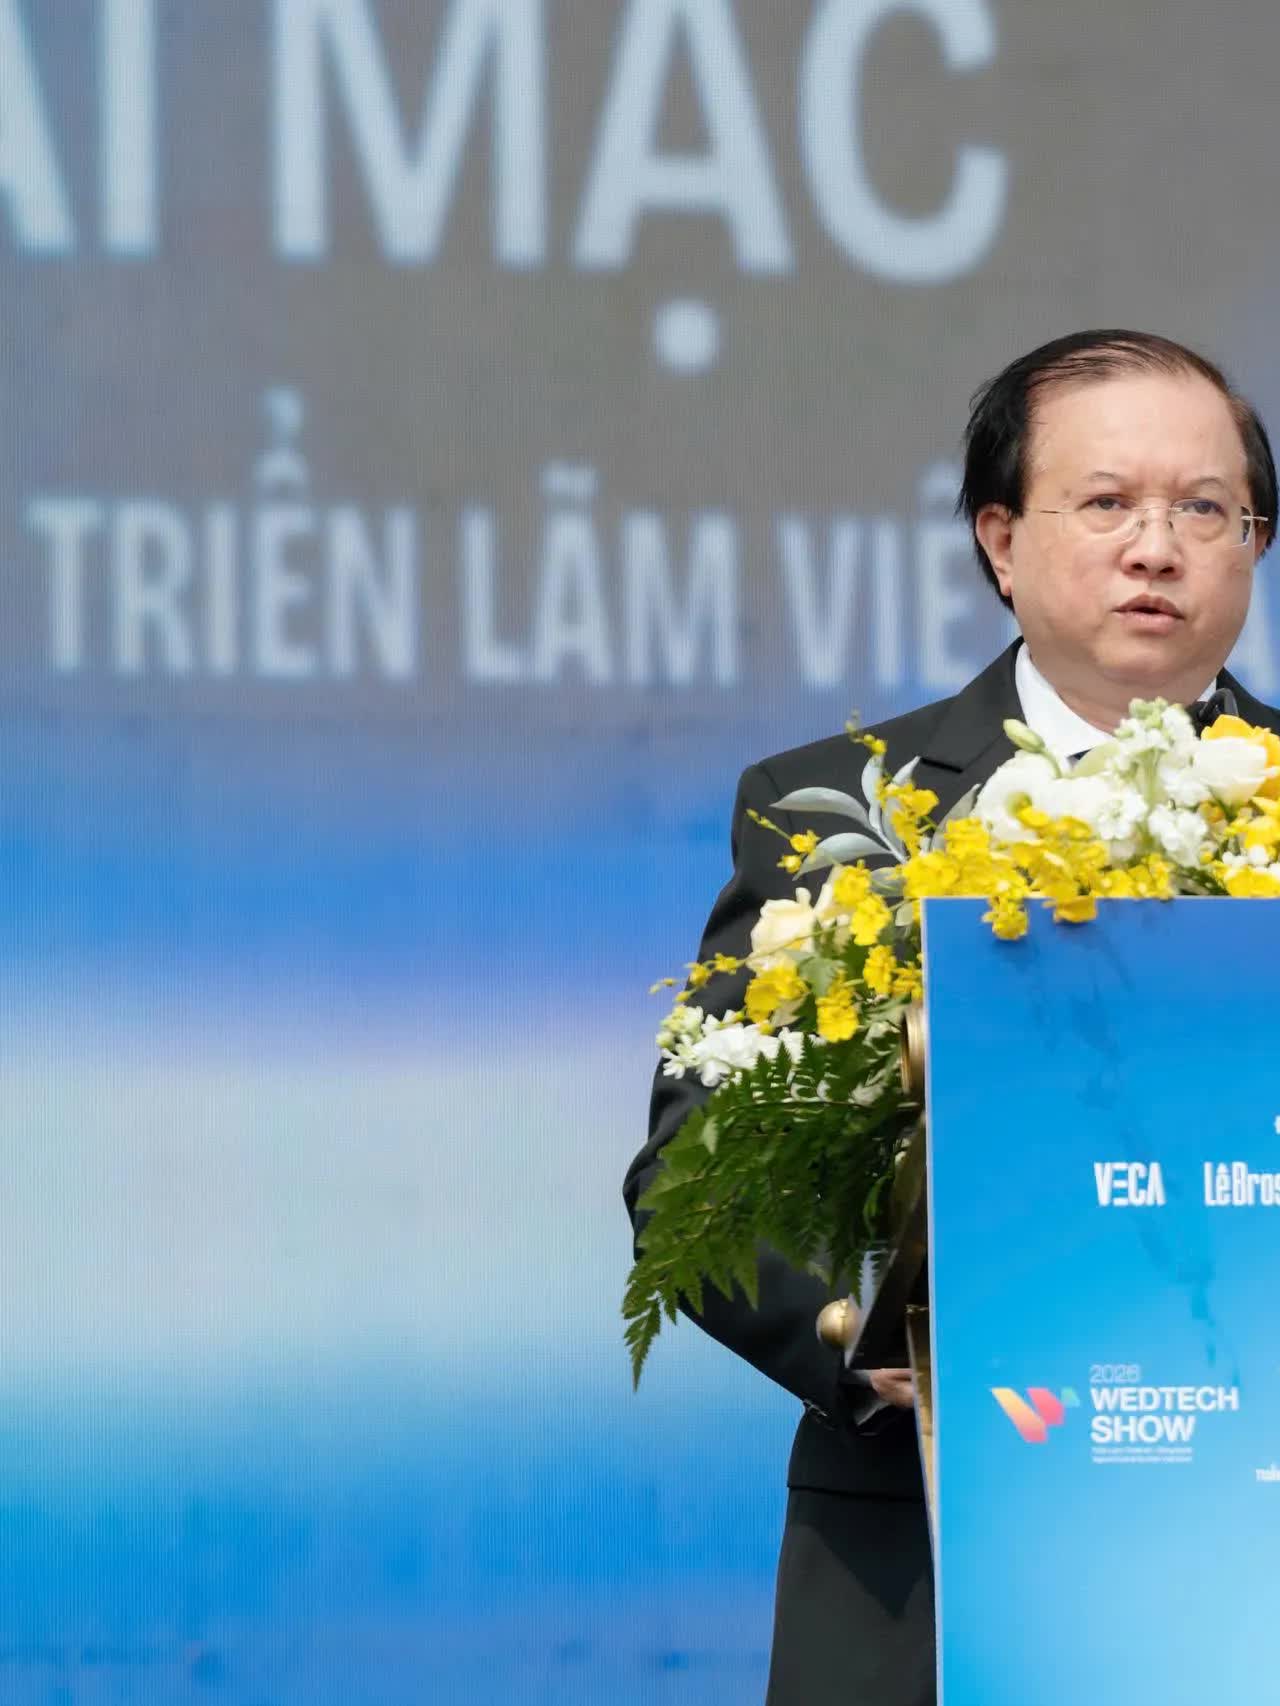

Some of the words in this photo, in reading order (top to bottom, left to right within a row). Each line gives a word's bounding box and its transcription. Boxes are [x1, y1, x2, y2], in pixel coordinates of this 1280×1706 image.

[272, 0, 1008, 376] MẠC
[22, 386, 420, 682] TRIỂN
[459, 462, 741, 690] LÃM
[1090, 1386, 1239, 1412] WEDTECH
[1090, 1415, 1196, 1444] SHOW
